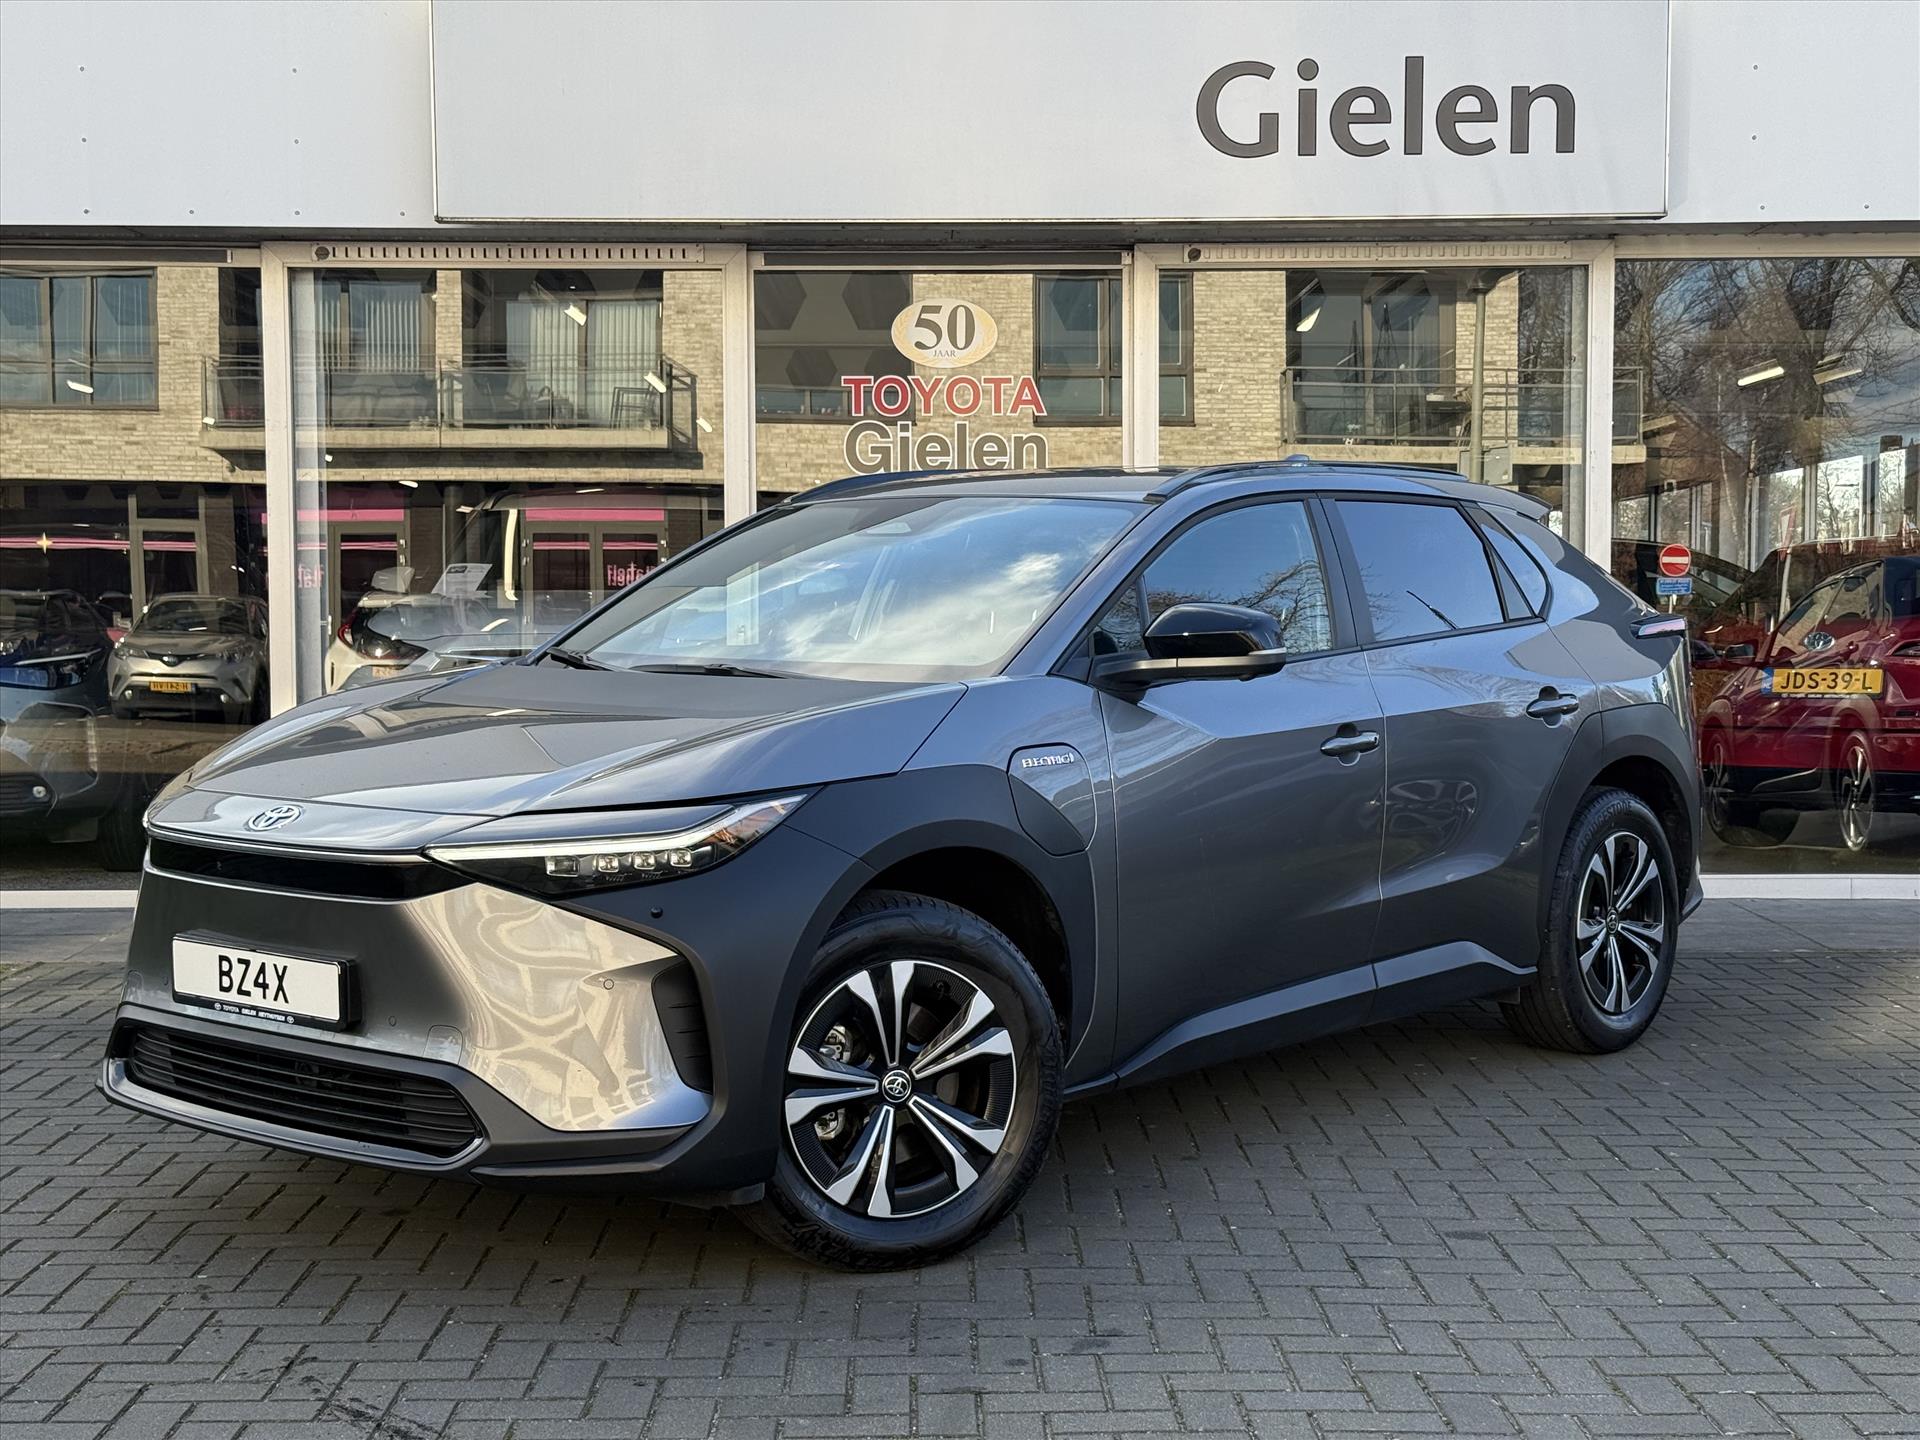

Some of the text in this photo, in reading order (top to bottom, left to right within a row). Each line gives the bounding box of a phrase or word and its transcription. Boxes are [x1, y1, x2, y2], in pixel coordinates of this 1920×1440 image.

[1196, 55, 1576, 158] Gielen
[914, 304, 976, 351] 50
[933, 350, 957, 358] JAAR
[841, 375, 1048, 417] TOYOTA
[844, 420, 1049, 475] Gielen
[1780, 671, 1873, 690] JDS-39-L
[1022, 754, 1070, 768] ELECTRIC
[218, 954, 290, 1004] BZ4X
